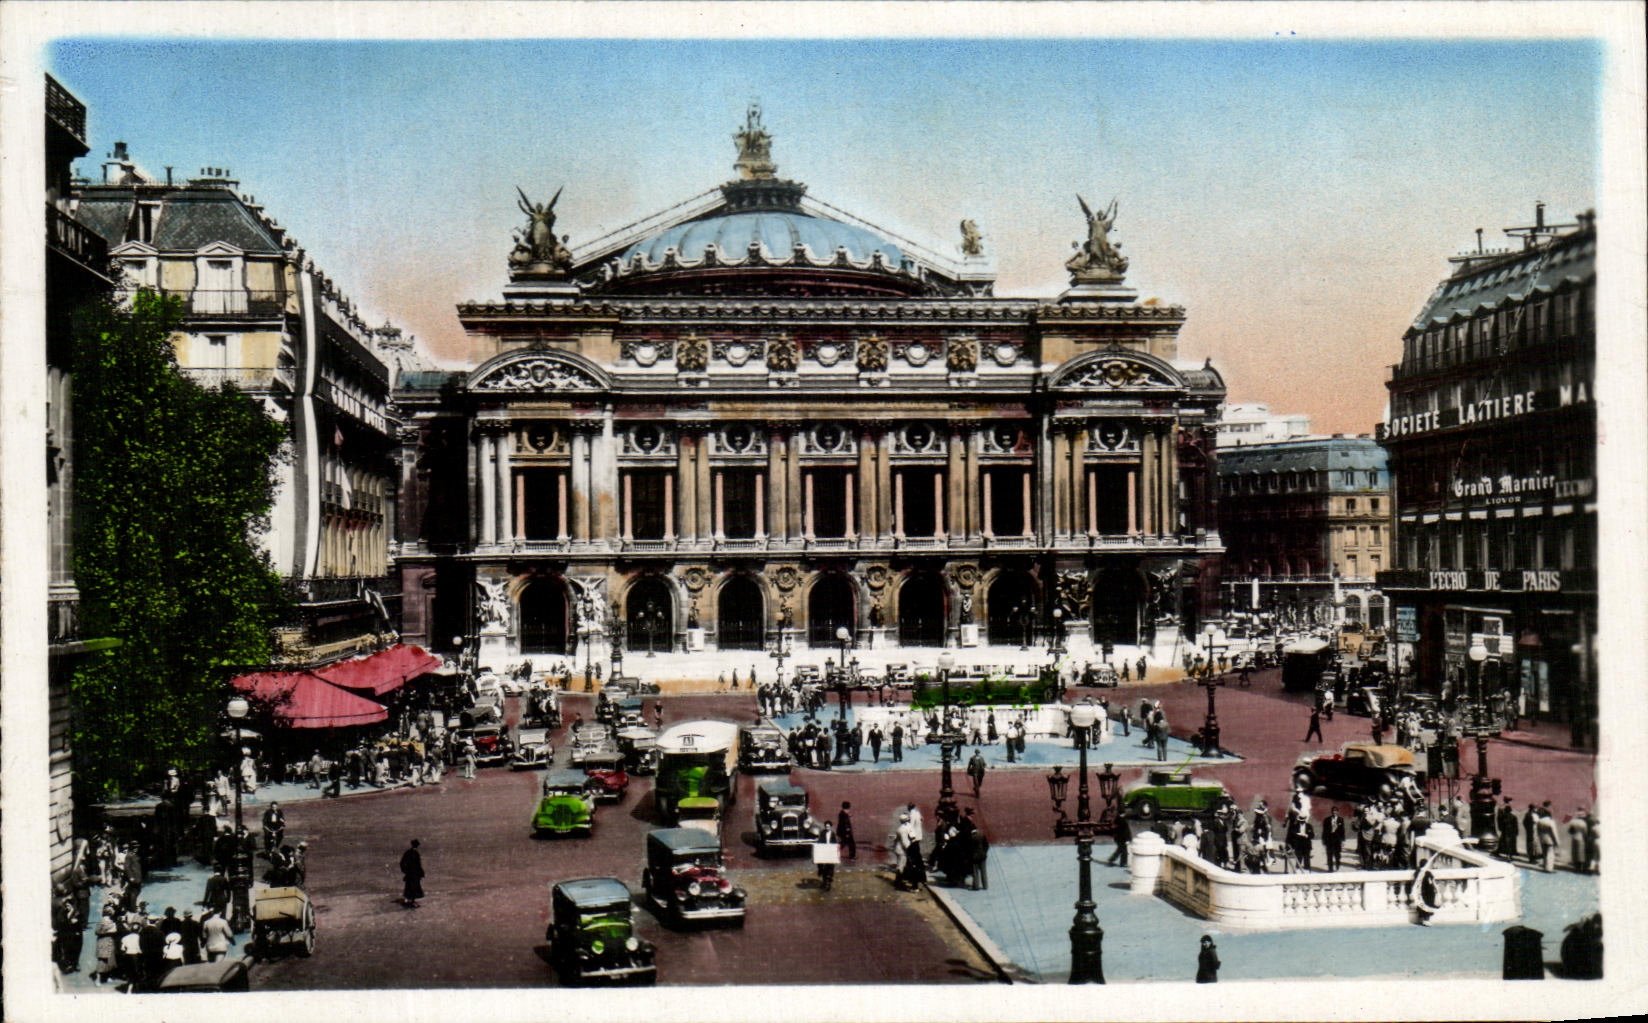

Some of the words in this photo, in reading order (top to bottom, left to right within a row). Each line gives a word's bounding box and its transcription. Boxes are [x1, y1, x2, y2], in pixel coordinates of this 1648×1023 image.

[1454, 476, 1493, 497] Grand
[1499, 469, 1555, 494] Marnier
[1429, 571, 1467, 591] L'ECHO
[1485, 571, 1500, 590] DE
[1522, 571, 1561, 591] PARIS
